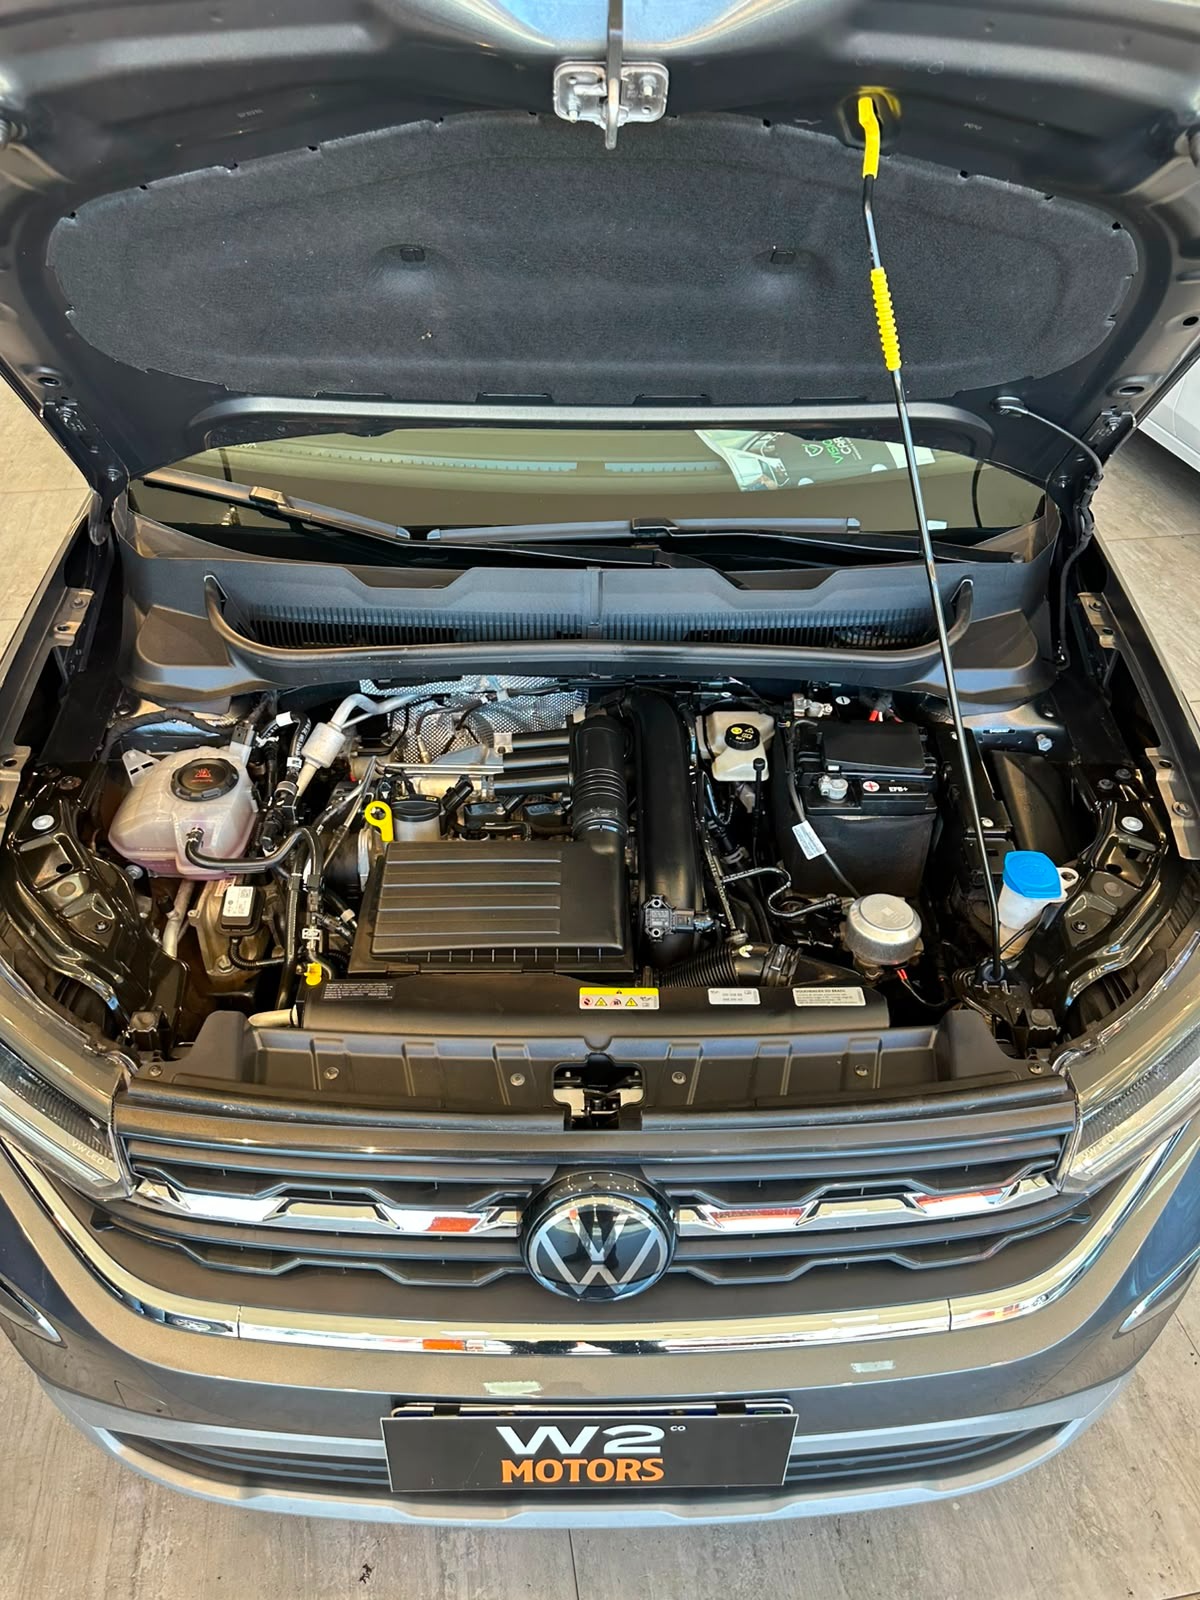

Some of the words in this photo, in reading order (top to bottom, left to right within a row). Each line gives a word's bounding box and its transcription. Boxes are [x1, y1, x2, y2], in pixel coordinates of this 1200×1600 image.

[72, 1140, 87, 1153] VW
[86, 1150, 105, 1165] LED
[501, 1458, 665, 1483] MOTORS
